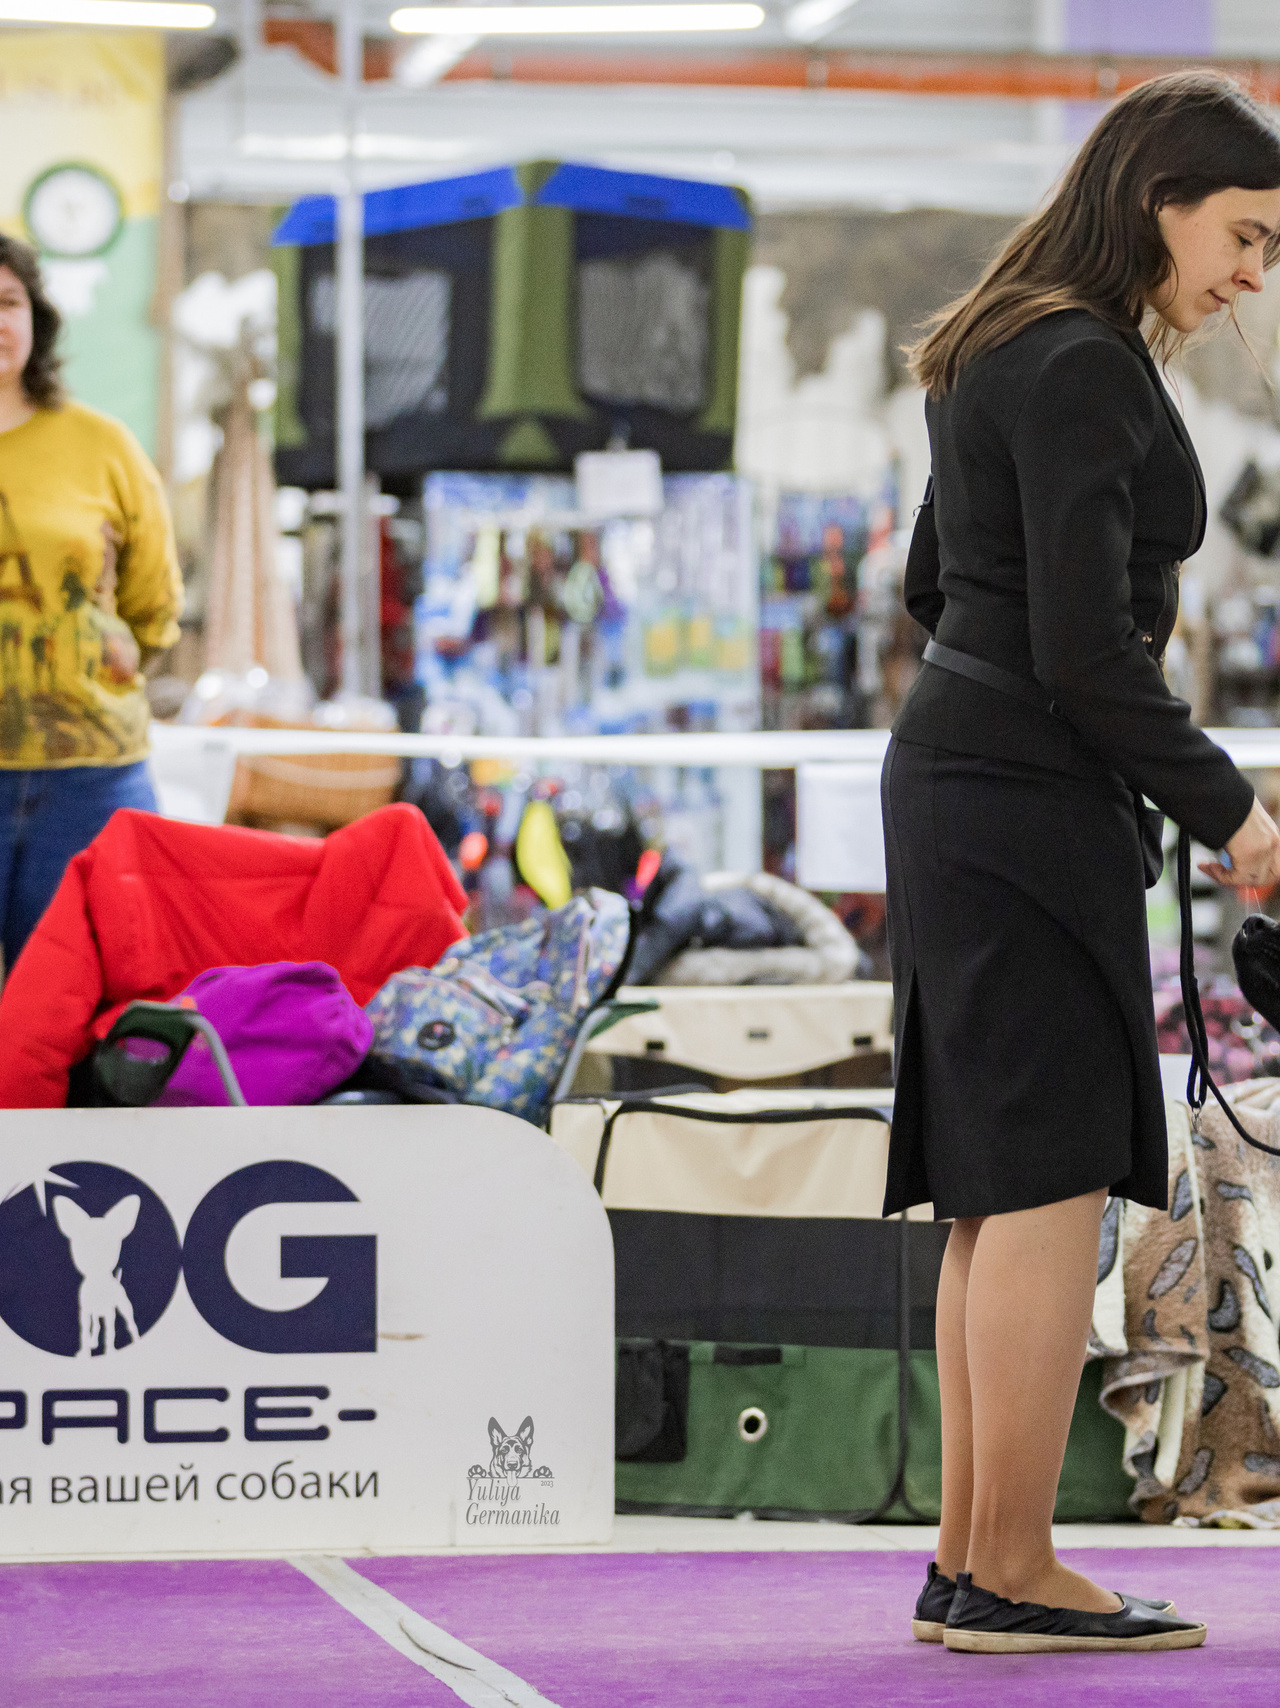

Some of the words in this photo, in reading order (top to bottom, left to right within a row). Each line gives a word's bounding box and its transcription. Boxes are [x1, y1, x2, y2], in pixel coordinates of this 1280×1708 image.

[0, 1160, 378, 1358] OG
[0, 1475, 32, 1505] я
[51, 1462, 200, 1505] вашей
[216, 1460, 380, 1501] собаки
